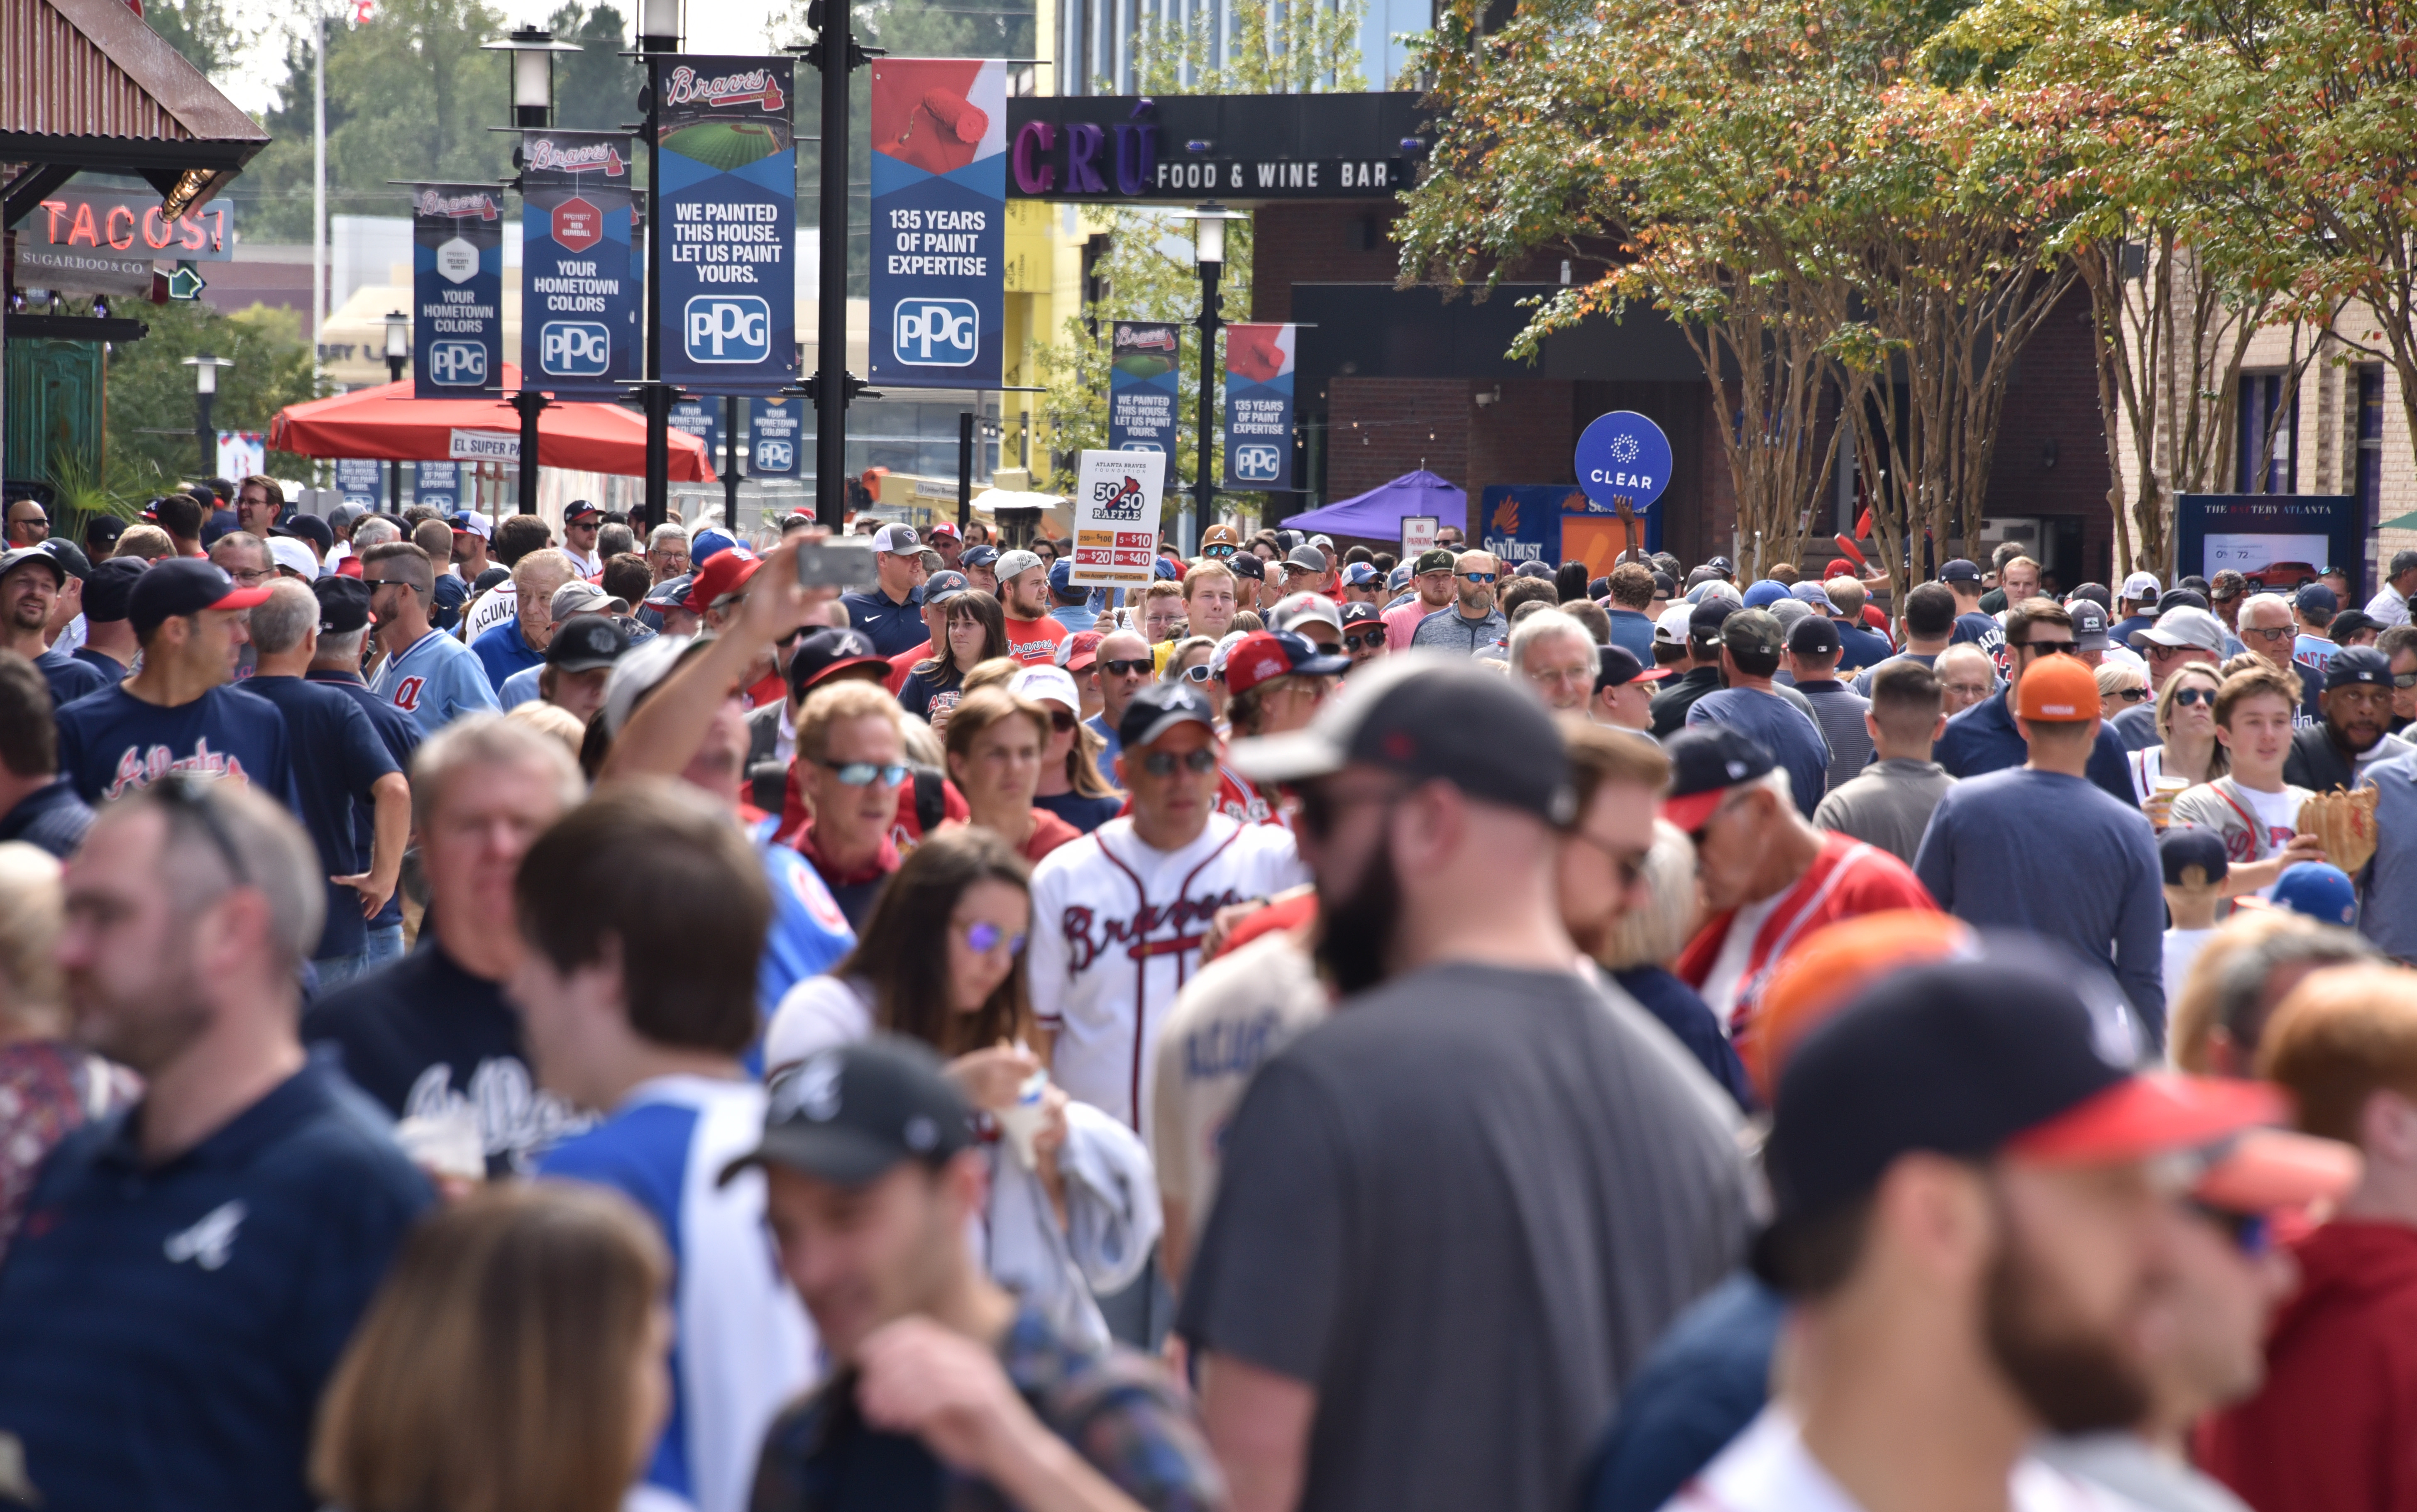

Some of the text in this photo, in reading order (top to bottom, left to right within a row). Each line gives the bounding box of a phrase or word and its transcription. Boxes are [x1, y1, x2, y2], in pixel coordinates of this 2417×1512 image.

[667, 66, 765, 106] Braves
[1013, 98, 1157, 195] CRÚ
[531, 140, 608, 171] Braves
[1157, 162, 1387, 188] FOOD & WINE BAR
[420, 191, 485, 217] Braves
[676, 203, 777, 222] WE PAINTED
[890, 210, 985, 230] 135 YEARS
[40, 201, 223, 252] TACOS!
[673, 224, 780, 242] THIS HOUSE.
[897, 232, 978, 253] OF PAINT
[672, 244, 782, 262] LET US PAINT
[23, 252, 145, 274] SUGARBOO & CO.
[558, 261, 596, 277] YOUR
[888, 255, 987, 276] EXPERTISE
[696, 265, 758, 283] YOURS.
[534, 278, 618, 295] HOMETOWN
[442, 291, 475, 304] YOUR
[547, 296, 606, 312] COLORS
[423, 305, 494, 318] HOMETOWN
[435, 320, 483, 332] COLORS
[691, 303, 765, 356] PPG
[900, 306, 973, 357] PPG
[546, 328, 605, 369] PPG
[434, 346, 483, 380] PPG
[1117, 396, 1170, 406] WE PAINTED
[1235, 401, 1284, 411] 135 YEARS
[680, 407, 701, 415] YOUR
[1117, 406, 1170, 417] THIS HOUSE.
[1238, 413, 1280, 423] OF PAINT
[669, 416, 713, 425] HOMETOWN
[755, 418, 798, 427] HOMETOWN
[1115, 416, 1171, 427] LET US PAINT
[1127, 427, 1158, 437] YOURS.
[1233, 424, 1284, 435] EXPERTISE
[455, 439, 467, 452] EL
[471, 440, 506, 455] SUPER
[760, 445, 789, 467] PPG
[1239, 449, 1276, 476] PPG
[1591, 469, 1652, 489] CLEAR
[1095, 484, 1119, 500] 50
[1119, 493, 1142, 509] 50
[1093, 509, 1140, 520] RAFFLE
[2204, 505, 2227, 513] THE
[2284, 505, 2331, 514] ATLANTA
[1416, 525, 1424, 533] NO
[1097, 533, 1112, 542] $100
[1132, 534, 1151, 547] $10
[1407, 537, 1432, 546] PARKING
[1091, 551, 1110, 564] $20
[1129, 552, 1149, 565] $40
[476, 598, 515, 634] ACUÑA
